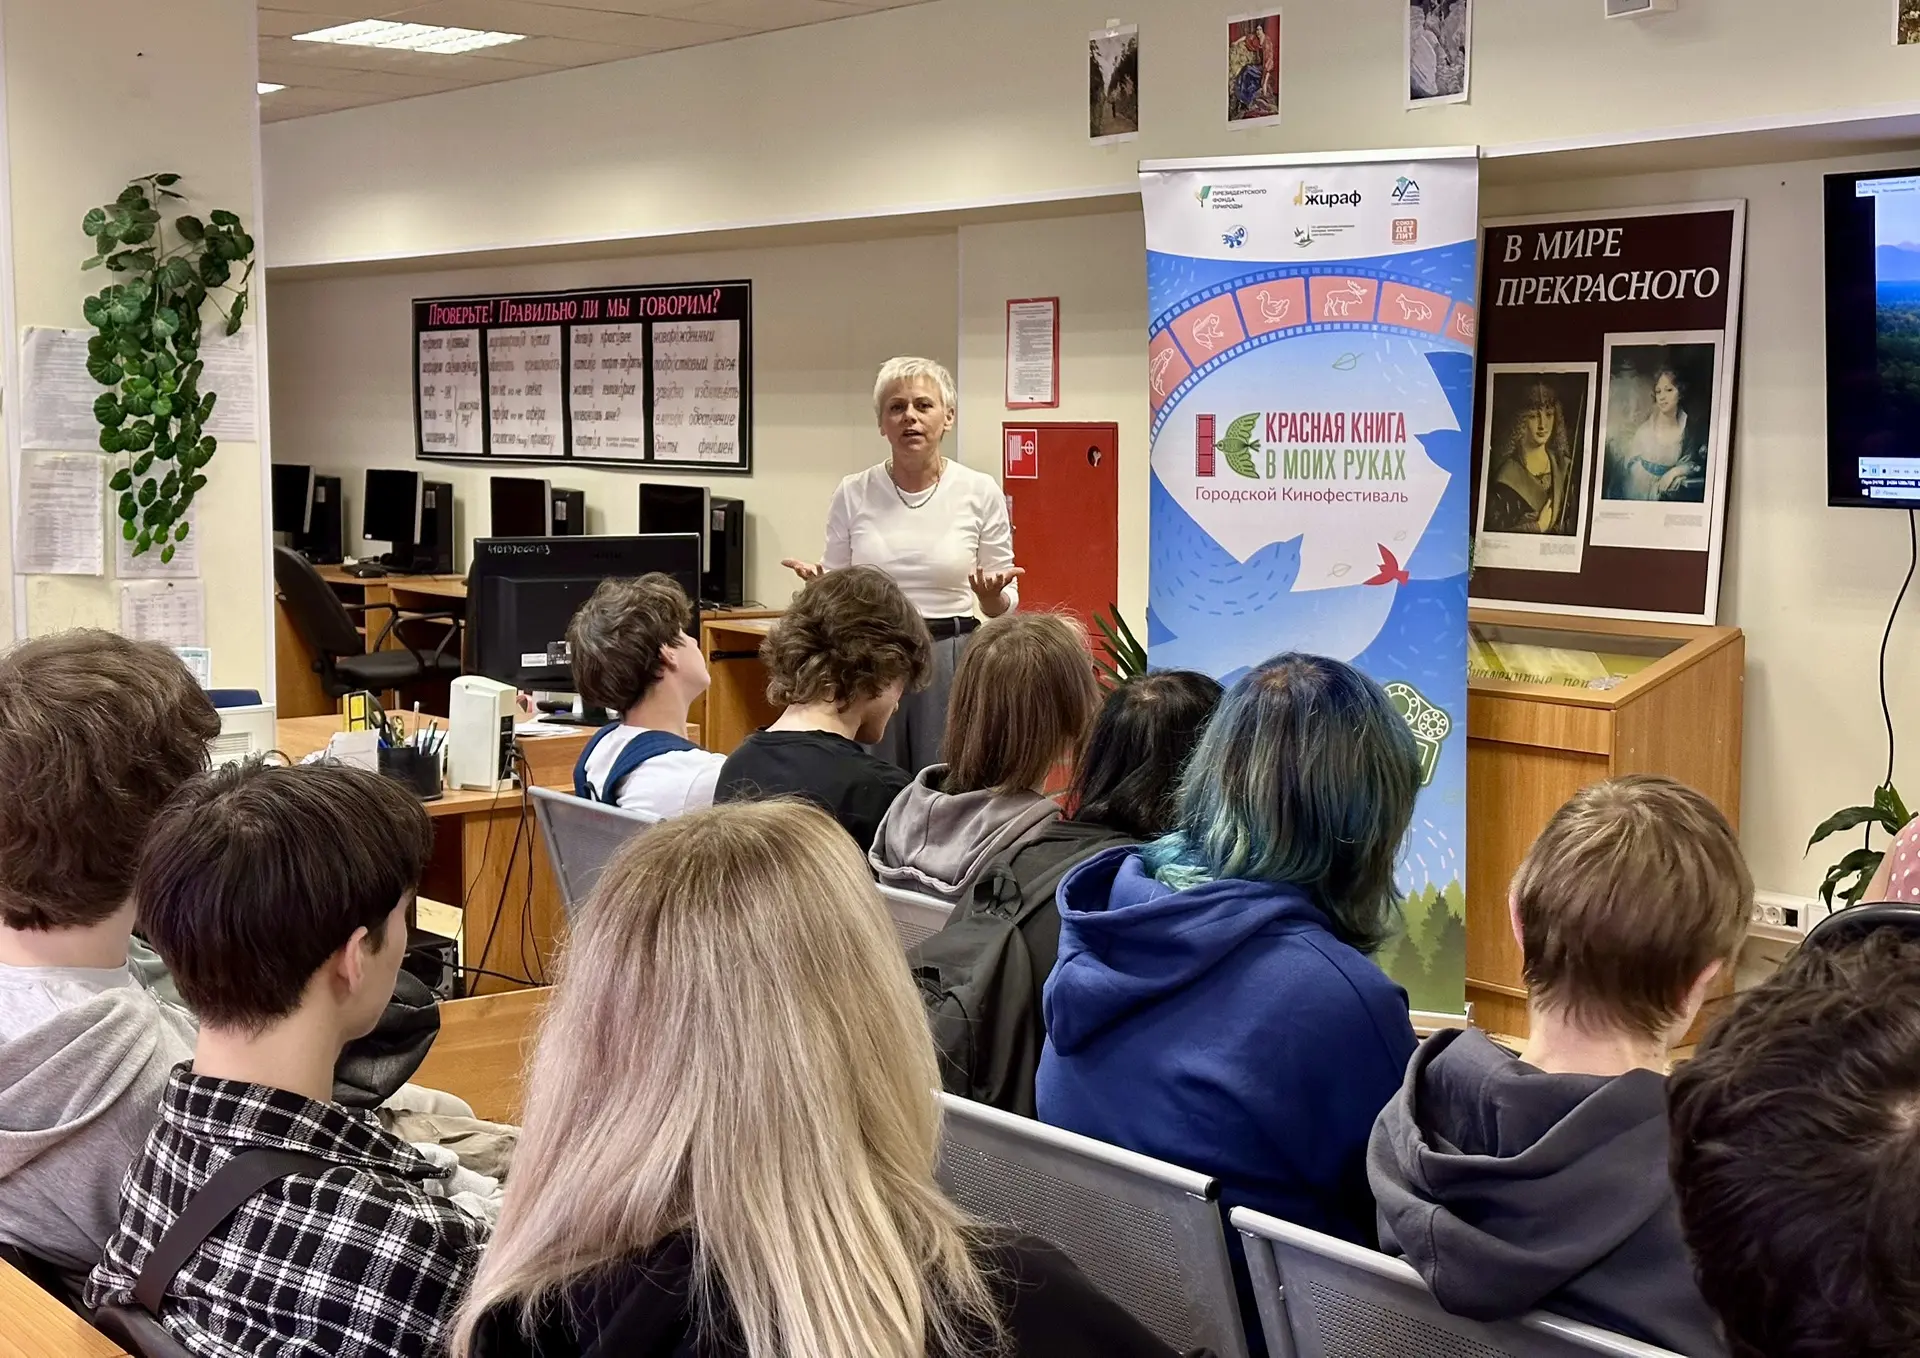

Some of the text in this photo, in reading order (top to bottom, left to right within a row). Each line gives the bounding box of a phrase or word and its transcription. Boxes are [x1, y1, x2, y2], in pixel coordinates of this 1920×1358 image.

[1304, 189, 1362, 208] жираф
[1503, 227, 1623, 262] В МИРЕ
[1495, 266, 1720, 307] ПРЕКРАСНОГО
[1265, 411, 1407, 443] КРАСНАЯ КНИГА
[1265, 449, 1407, 481] В МОИХ РУКАХ
[1195, 486, 1409, 504] Городской Кинофестиваль
